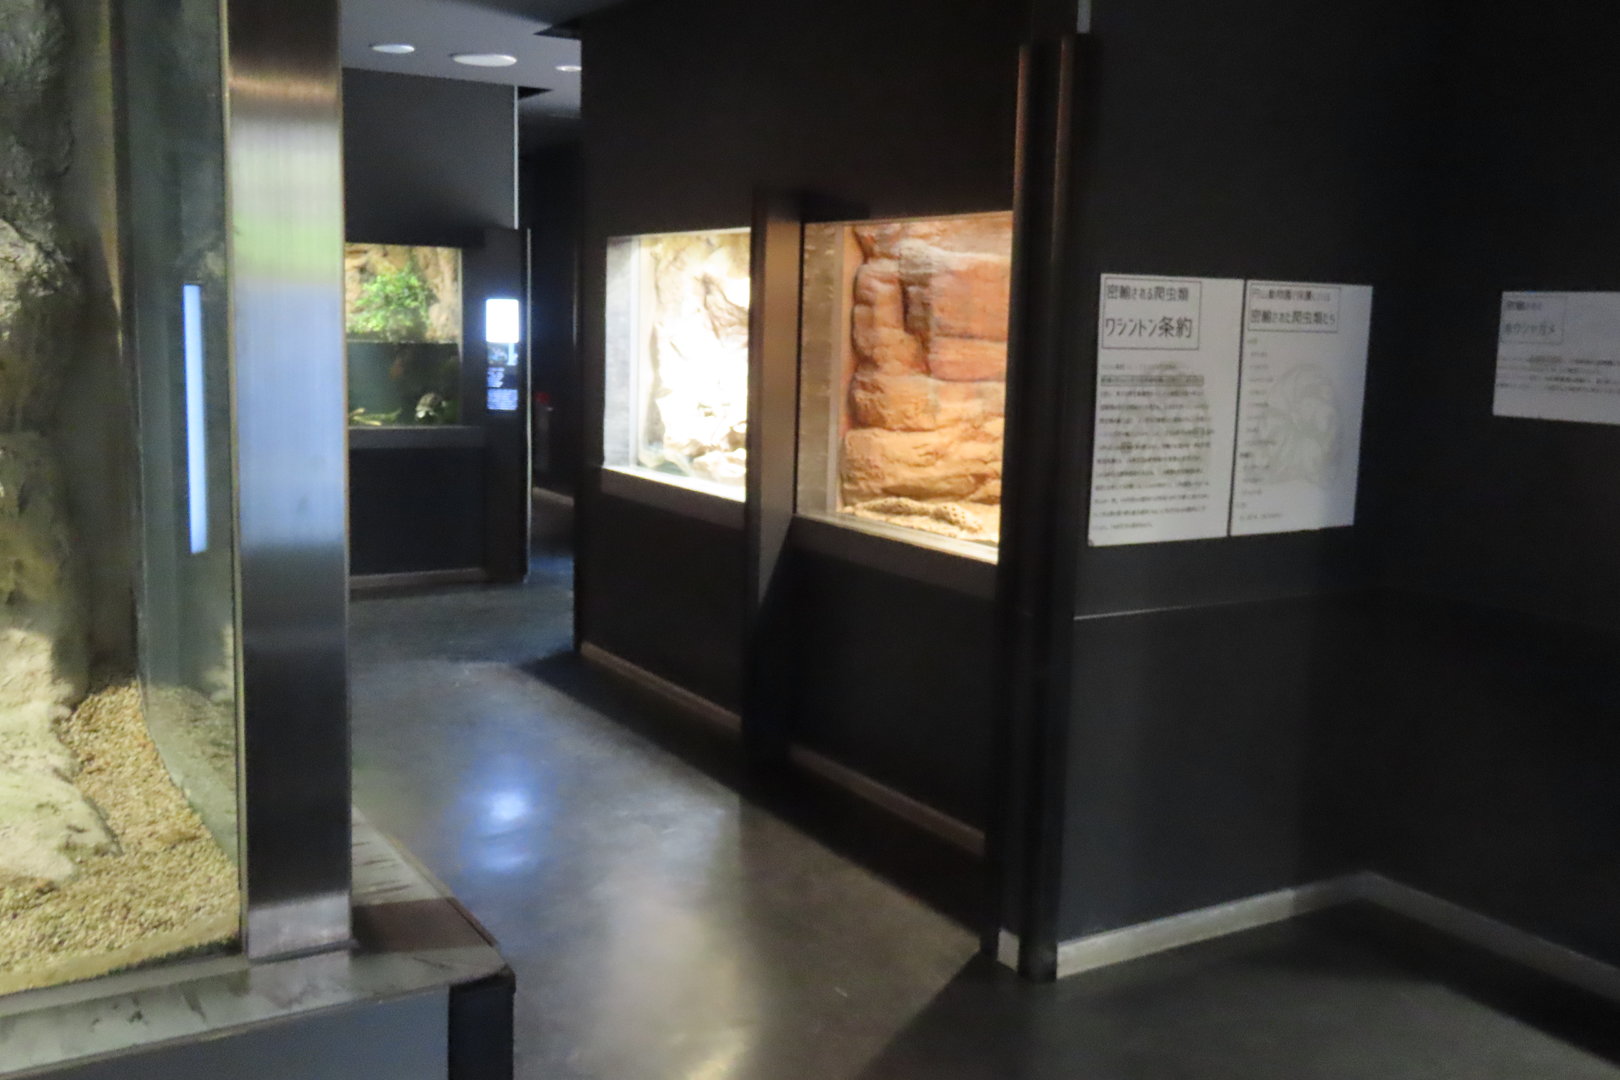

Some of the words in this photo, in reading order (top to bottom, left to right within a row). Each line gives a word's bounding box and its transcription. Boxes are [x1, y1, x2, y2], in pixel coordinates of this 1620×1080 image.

[1105, 316, 1192, 338] ワシントン条約
